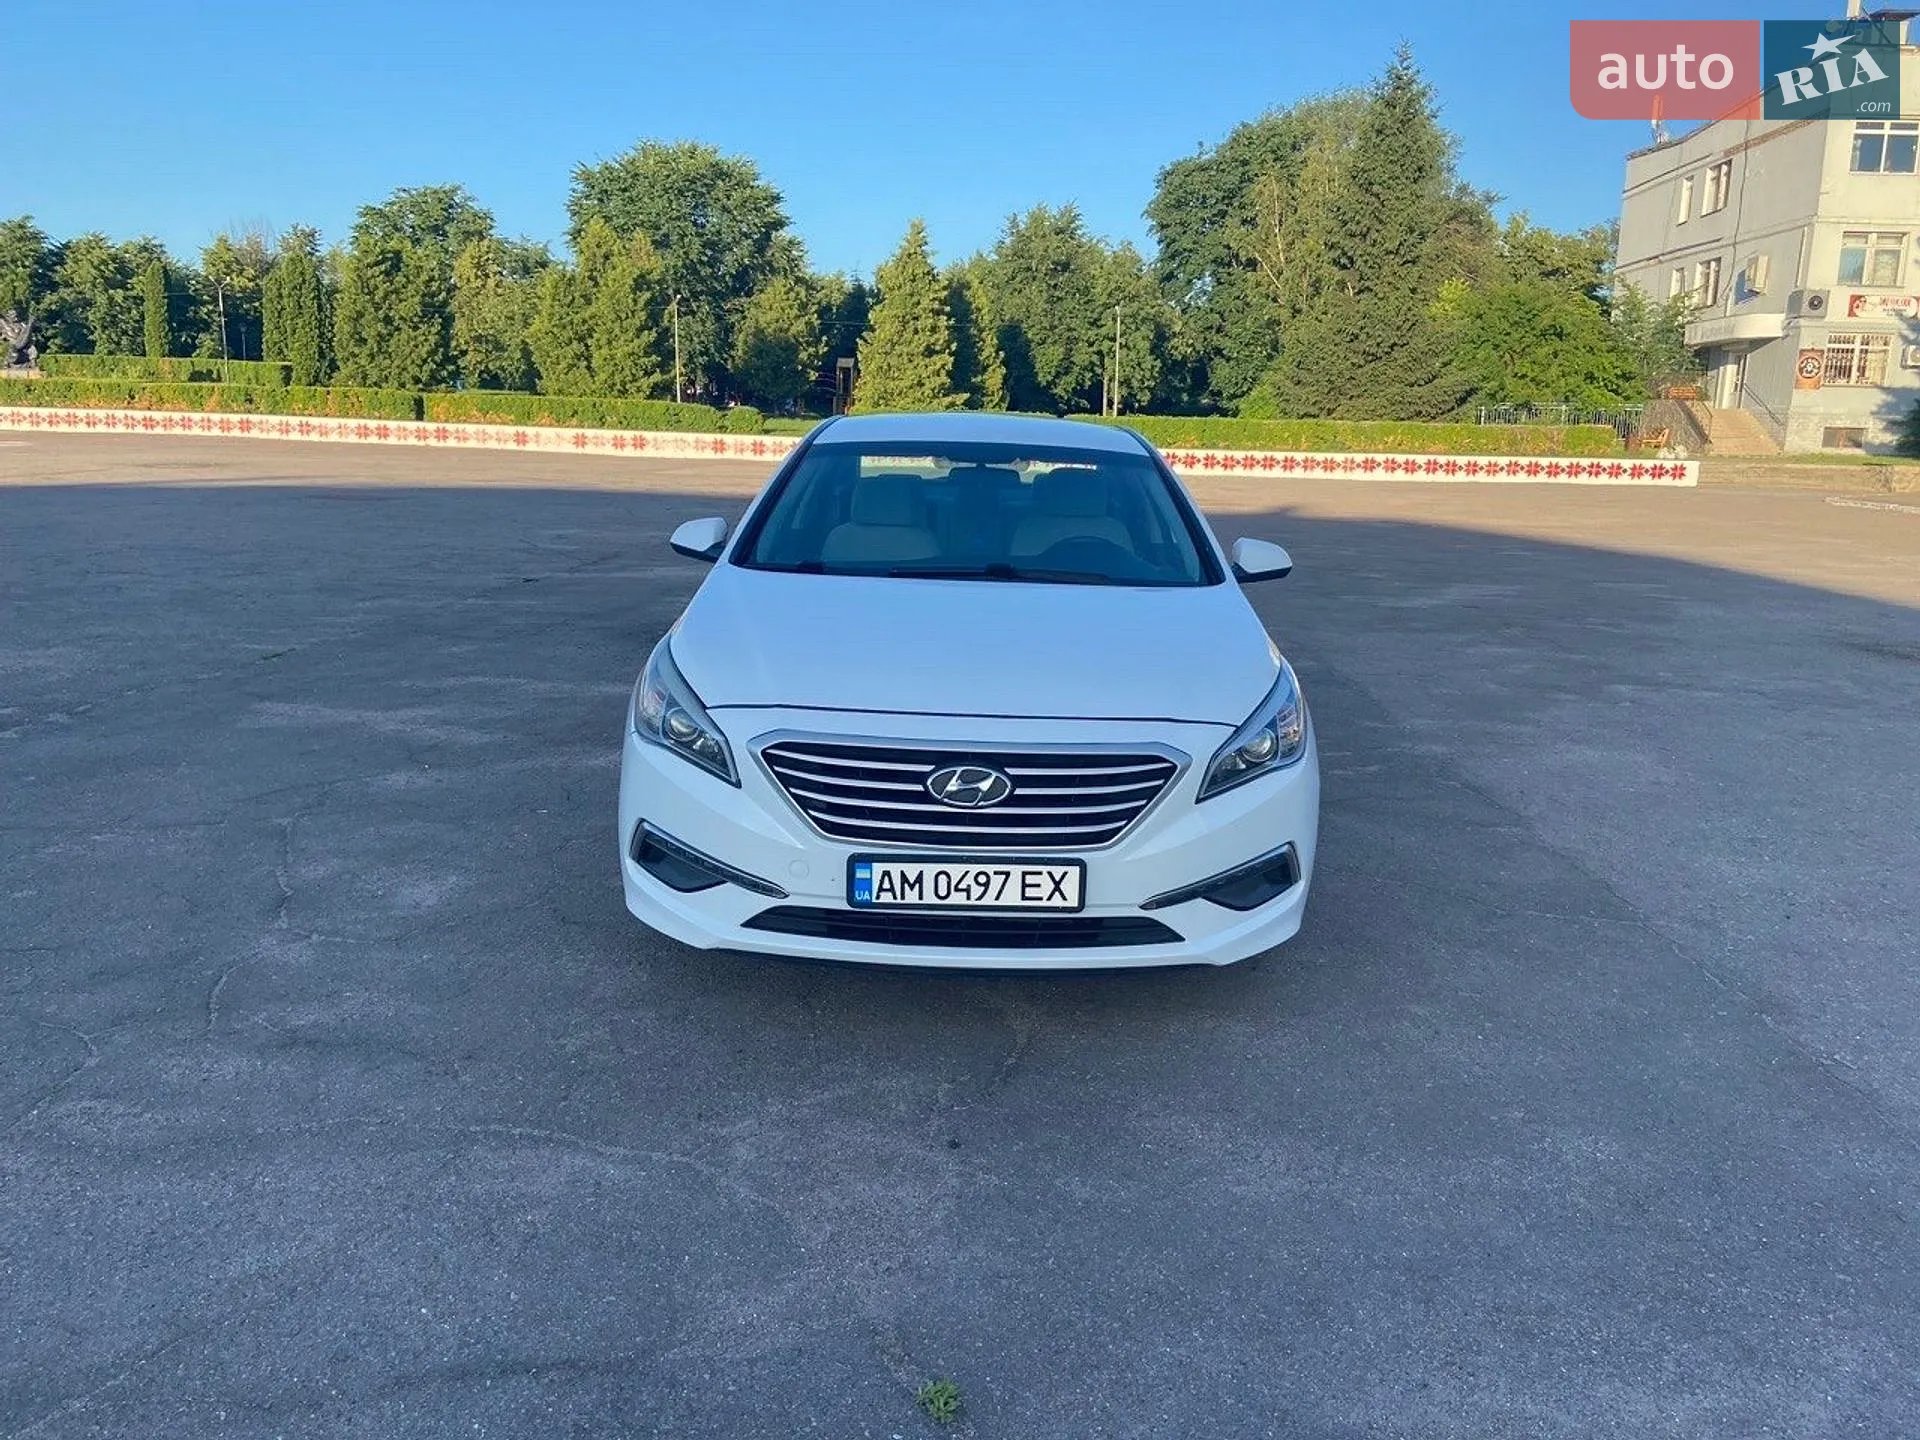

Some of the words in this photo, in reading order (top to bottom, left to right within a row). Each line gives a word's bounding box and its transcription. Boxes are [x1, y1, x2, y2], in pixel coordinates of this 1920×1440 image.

[855, 890, 871, 901] UA
[875, 869, 924, 902] AM
[934, 869, 1011, 902] 0497
[1020, 870, 1069, 902] EX
